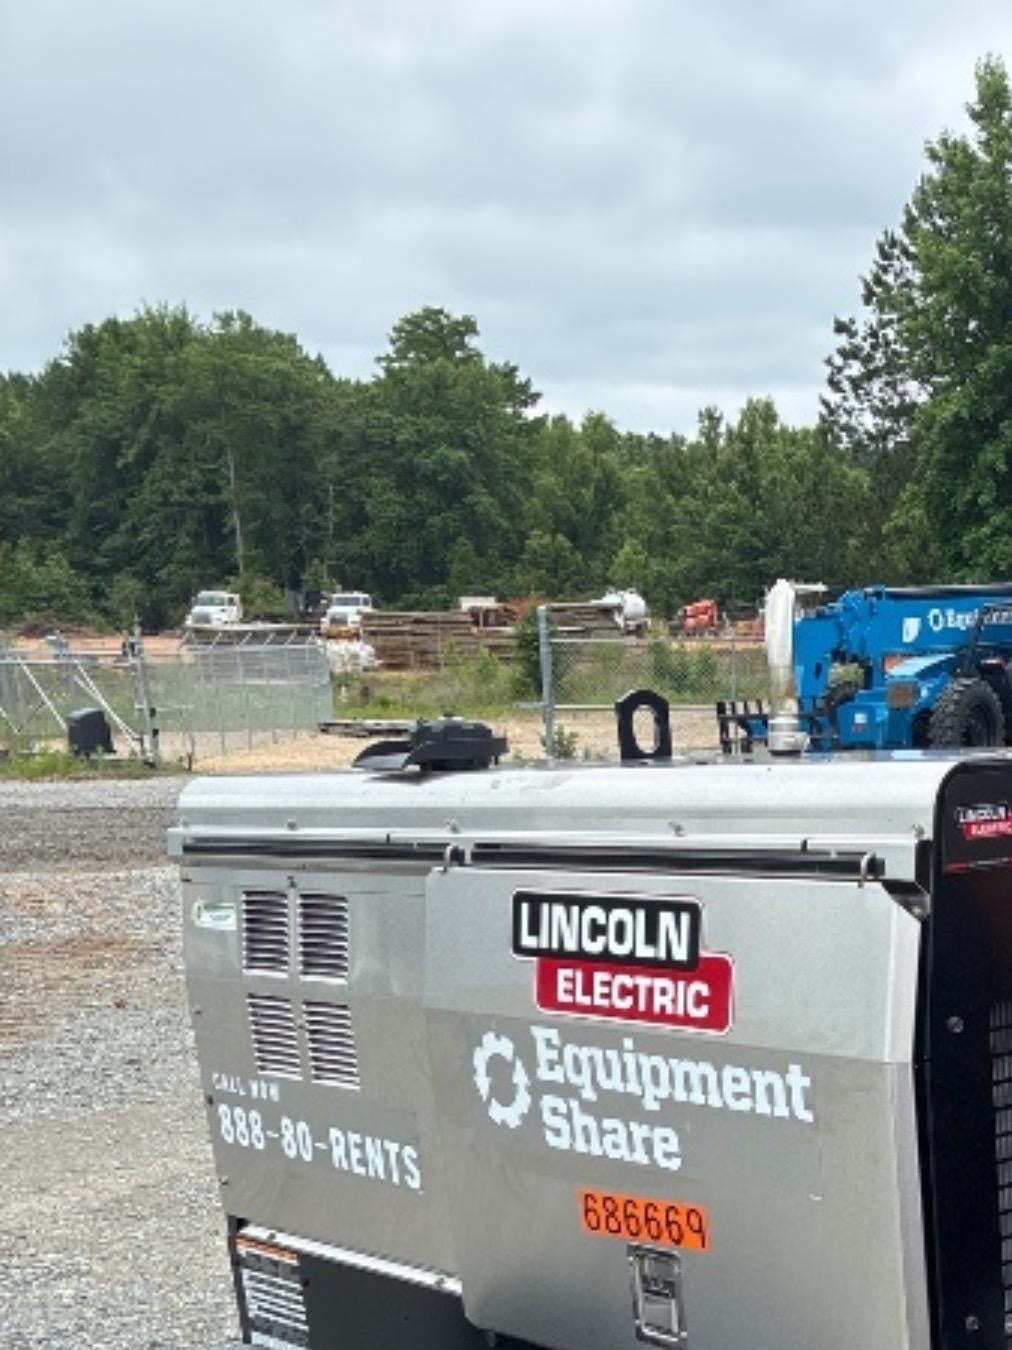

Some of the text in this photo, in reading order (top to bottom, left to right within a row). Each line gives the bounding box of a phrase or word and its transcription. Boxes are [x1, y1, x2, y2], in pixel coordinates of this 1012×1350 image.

[519, 901, 691, 961] LINCOLN
[555, 968, 710, 1018] ELECTRIC
[529, 1025, 814, 1123] Equipment
[217, 1102, 422, 1190] 888-80-RENTS
[540, 1093, 683, 1171] Share
[582, 1192, 708, 1249] 686669
